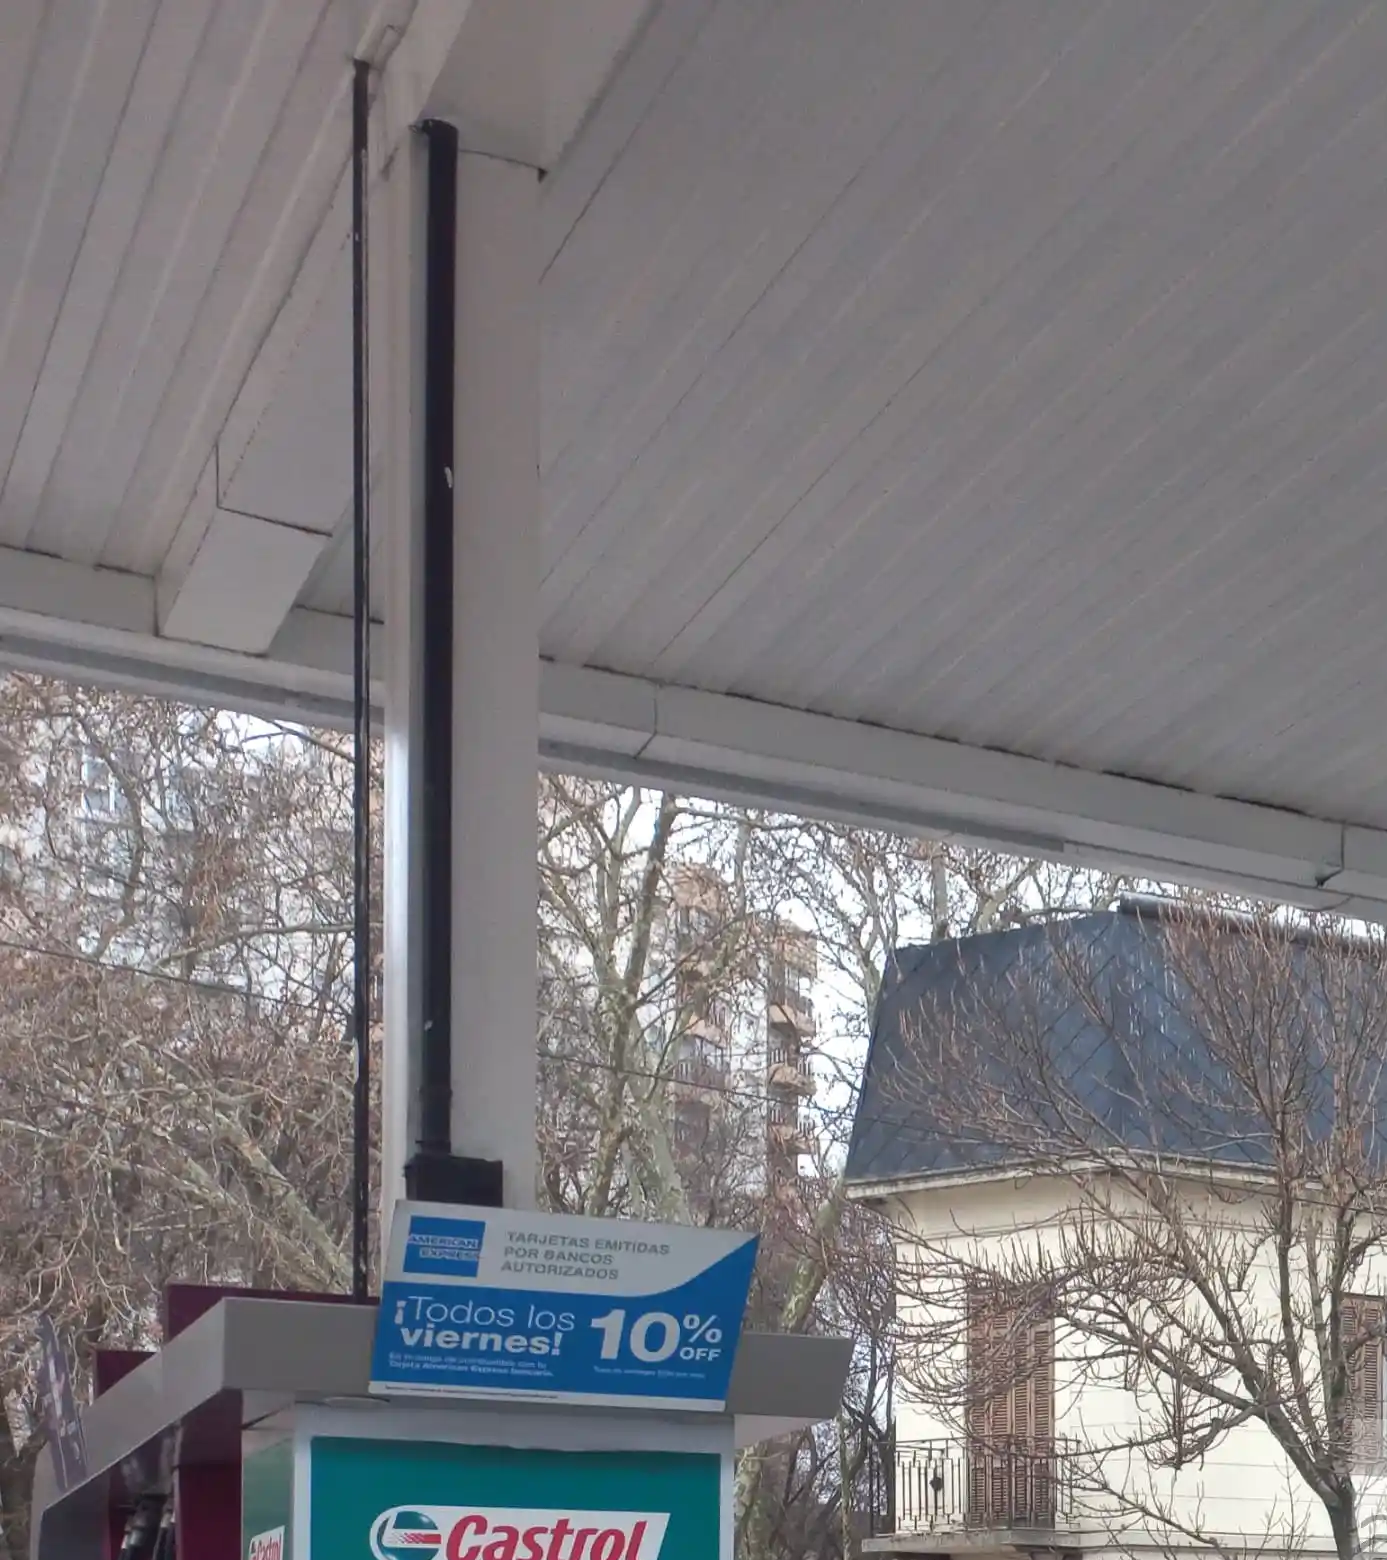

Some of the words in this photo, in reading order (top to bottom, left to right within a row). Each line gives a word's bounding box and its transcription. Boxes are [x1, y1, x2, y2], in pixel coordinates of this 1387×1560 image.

[408, 1234, 480, 1249] AMERICAN
[506, 1230, 591, 1249] TARJETAS
[595, 1236, 671, 1256] EMITIDAS
[504, 1246, 540, 1260] POR
[544, 1248, 615, 1267] BANCOS
[501, 1261, 620, 1281] AUTORIZADOS
[393, 1295, 515, 1328] ¡Todos
[527, 1303, 575, 1332] los
[400, 1325, 564, 1358] viernes!
[590, 1308, 723, 1364] 10%
[679, 1346, 722, 1363] OFF
